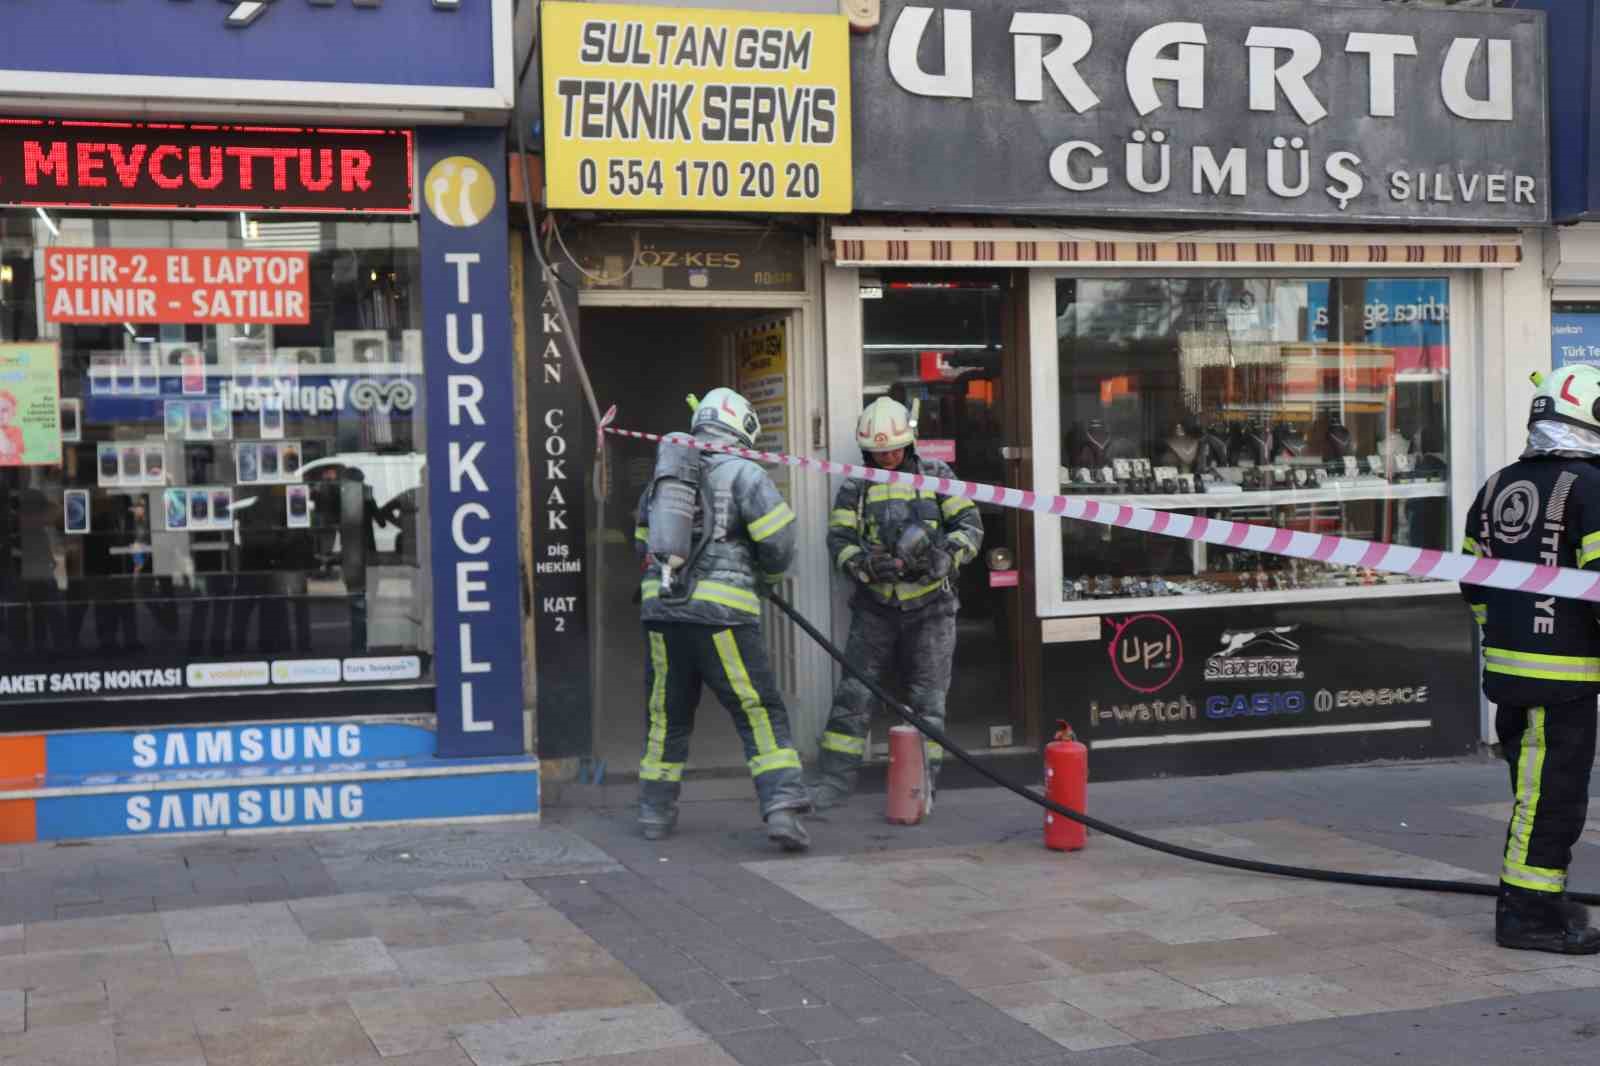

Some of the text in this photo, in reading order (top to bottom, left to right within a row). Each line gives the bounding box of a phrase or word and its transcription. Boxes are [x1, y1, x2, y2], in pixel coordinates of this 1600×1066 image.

[580, 21, 812, 71] SULTAN GSM
[888, 6, 1513, 125] URARTU
[23, 140, 373, 192] MEVCUTTUR
[579, 158, 820, 199] 0 554 170 20 20
[1048, 129, 1537, 210] GÜMÜŞ SILVER
[49, 252, 304, 284] SIFIR-2. EL LAPTOP
[51, 287, 156, 317] ALINIR
[192, 289, 304, 318] SATILIR
[544, 408, 568, 530] ÇOKAK
[444, 252, 495, 733] TURKCELL
[543, 597, 576, 613] KAT
[555, 617, 565, 632] 2
[1122, 634, 1172, 670] Up!
[1204, 657, 1303, 680] Slazenger
[50, 671, 101, 692] SATIŞ
[104, 668, 182, 690] NOKTASI
[1090, 695, 1197, 727] i-watch
[1205, 691, 1305, 720] CASIO
[132, 724, 362, 768] SAMSUNG
[126, 784, 364, 831] SAMSUNG
